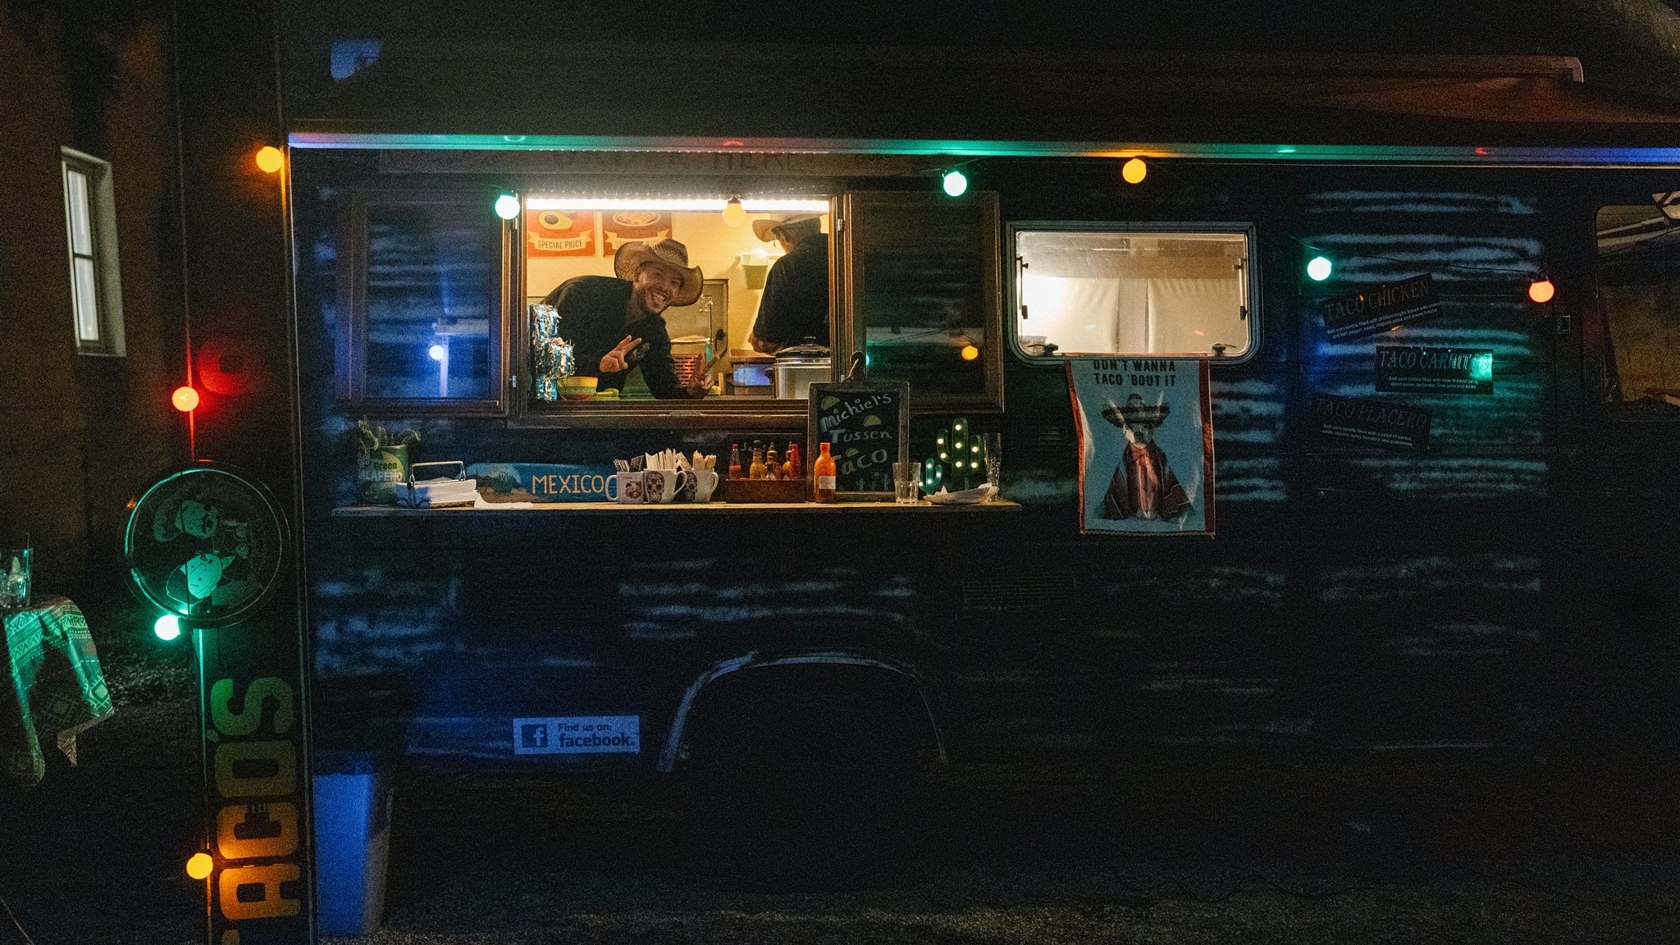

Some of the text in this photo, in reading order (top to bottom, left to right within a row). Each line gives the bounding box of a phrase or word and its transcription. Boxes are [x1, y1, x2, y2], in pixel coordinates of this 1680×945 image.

[537, 239, 583, 249] SPECIAL PRICE
[1368, 279, 1430, 310] CHICKEN
[1093, 360, 1176, 372] DON'T WANNA
[1379, 351, 1417, 368] TACO
[1094, 373, 1176, 386] TACO 'BOUT IT
[829, 428, 892, 444] Tussen
[373, 462, 398, 470] Green
[531, 474, 605, 494] MEXICO
[558, 723, 579, 732] Find
